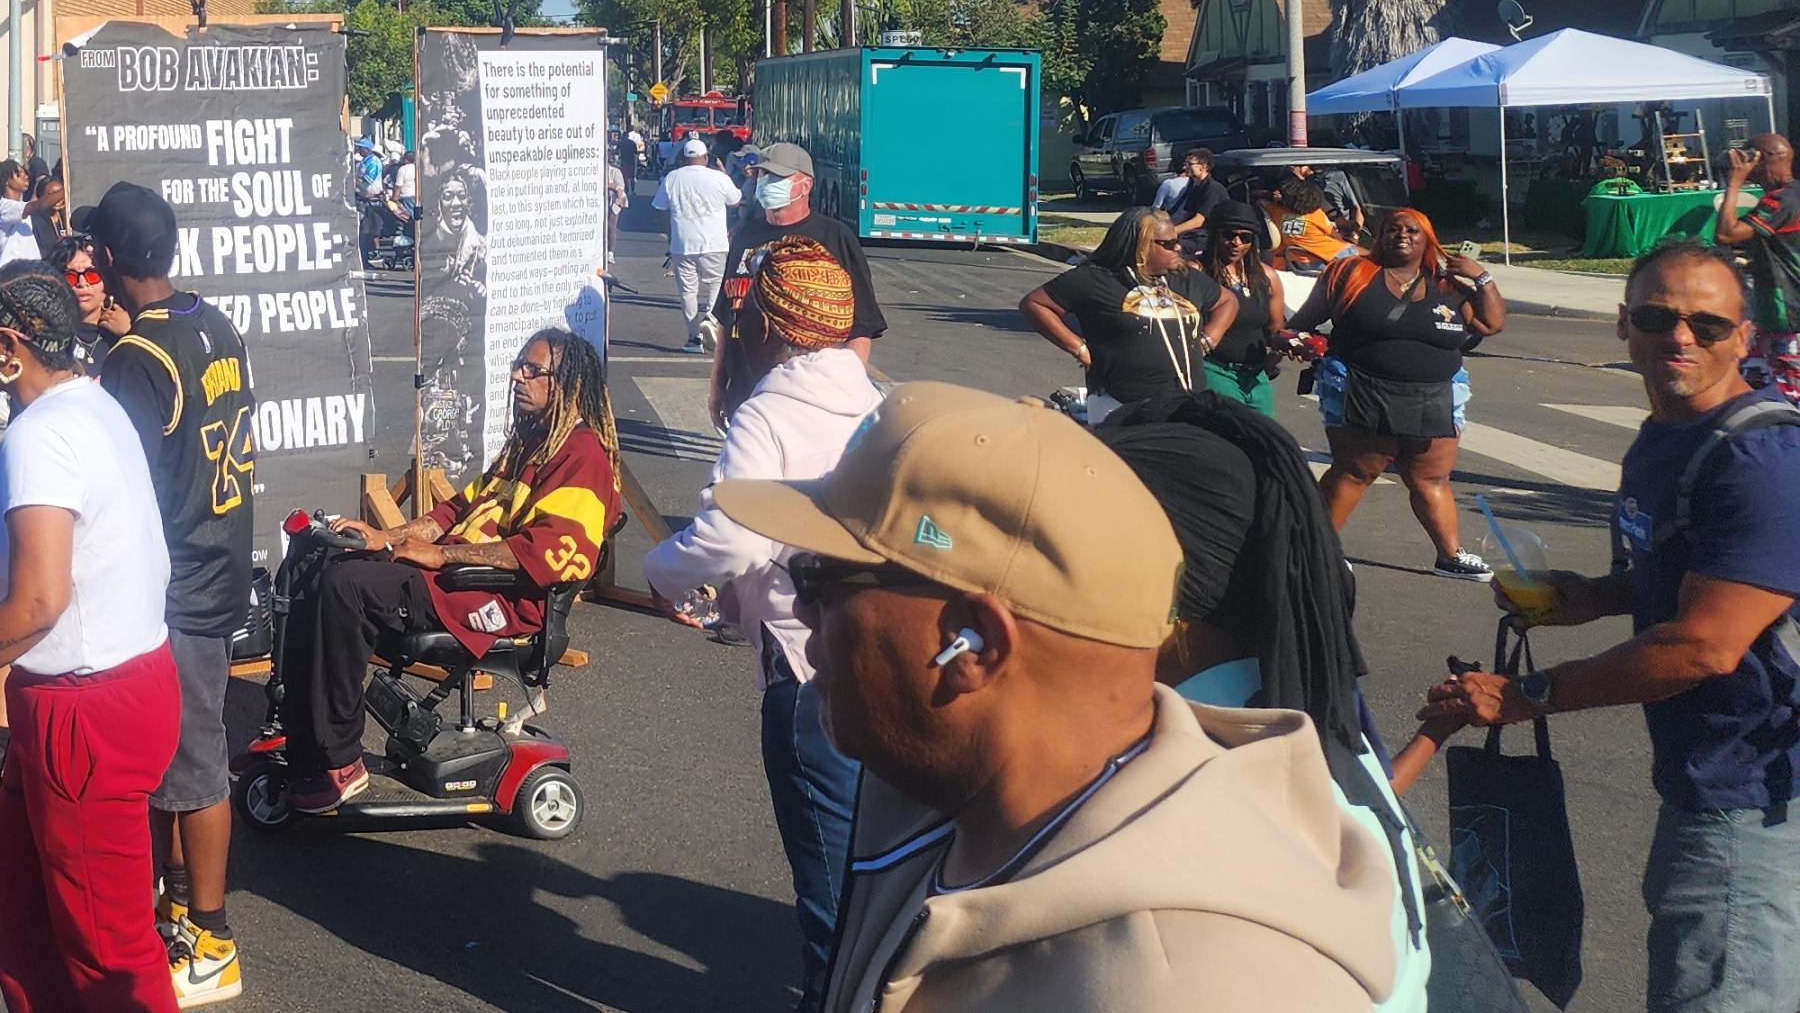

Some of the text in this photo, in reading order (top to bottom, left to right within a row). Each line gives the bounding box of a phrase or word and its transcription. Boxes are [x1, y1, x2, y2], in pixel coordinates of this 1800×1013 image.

[81, 46, 319, 91] FROM BOB AVAKIAN:
[483, 61, 594, 81] There is the potential
[485, 82, 571, 102] for something of
[486, 103, 565, 124] unprecedented
[114, 125, 201, 151] PROFOUND
[206, 118, 293, 166] FIGHT
[488, 123, 595, 144] beauty to arise out of
[489, 143, 599, 167] unspeakable ugliness:
[490, 168, 511, 181] Black
[512, 166, 538, 182] people
[540, 164, 566, 181] playing
[573, 163, 599, 176] crucial
[161, 170, 332, 218] FOR THE SOUL OF
[490, 186, 505, 198] role
[515, 183, 543, 199] putting
[582, 180, 597, 195] long
[517, 199, 532, 213] this
[535, 201, 561, 214] system
[563, 196, 584, 209] which
[492, 219, 504, 233] for
[535, 217, 547, 228] not
[549, 215, 564, 230] just
[212, 222, 343, 274] PEOPLE:
[491, 236, 505, 249] but
[491, 252, 507, 266] and
[509, 248, 547, 264] tormented
[549, 247, 568, 260] them
[490, 268, 528, 283] thousand
[491, 287, 508, 299] end
[509, 286, 518, 298] to
[541, 281, 554, 293] the
[556, 279, 572, 296] only
[258, 288, 359, 333] PEOPLE
[490, 304, 507, 316] can
[509, 302, 519, 314] be
[489, 317, 539, 333] emancipate
[490, 335, 518, 351] an end
[545, 536, 590, 581] 32
